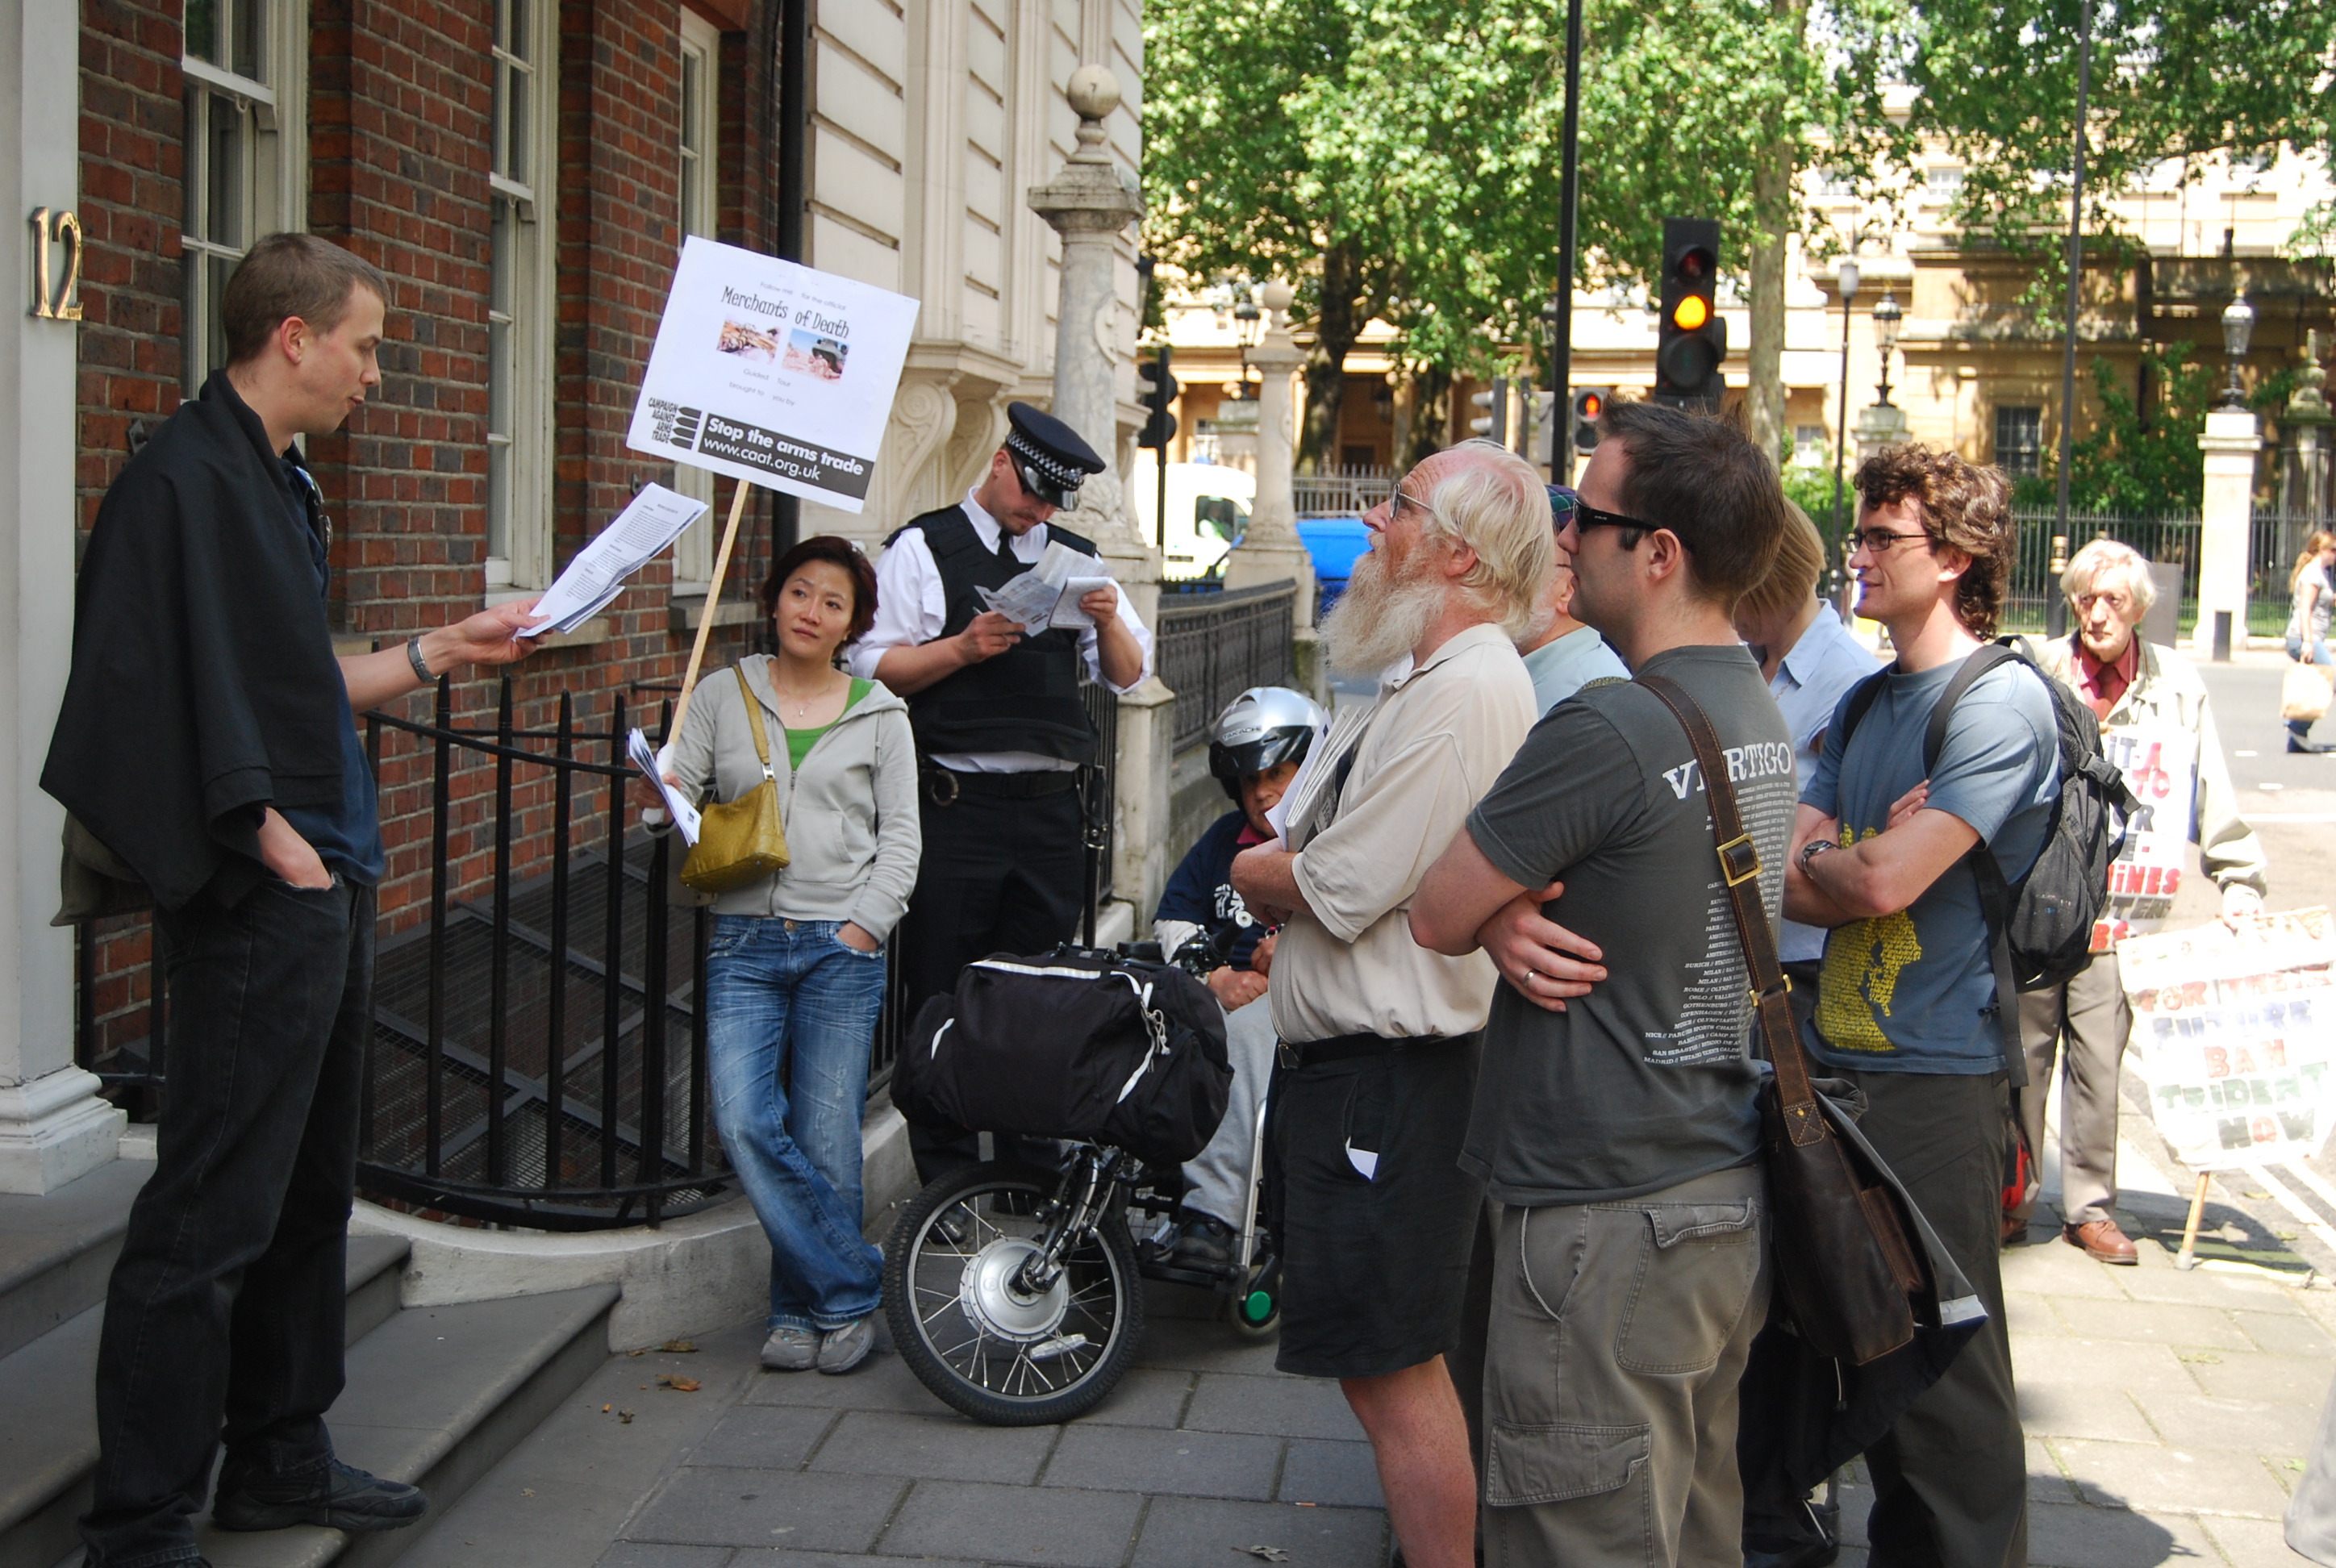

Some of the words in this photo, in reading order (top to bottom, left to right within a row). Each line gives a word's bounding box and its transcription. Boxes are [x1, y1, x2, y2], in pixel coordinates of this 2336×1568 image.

[29, 206, 83, 321] 12
[720, 285, 789, 319] Merchants
[795, 309, 812, 327] of
[811, 312, 850, 340] Death
[743, 368, 770, 381] Guided
[777, 377, 791, 387] Tour
[648, 397, 678, 414] CAMPAIGN
[729, 382, 757, 394] brought
[771, 394, 786, 403] you
[786, 398, 796, 407] by
[652, 409, 675, 423] AGAINST
[656, 420, 673, 434] ARMS
[652, 430, 670, 444] TRADE
[707, 418, 744, 441] Stop
[747, 428, 774, 448] the
[776, 440, 818, 462] arms
[820, 452, 864, 476] trade
[703, 438, 821, 481] www.caat.org.uk
[2204, 1038, 2288, 1078] BAN
[2217, 1107, 2315, 1151] NOW
